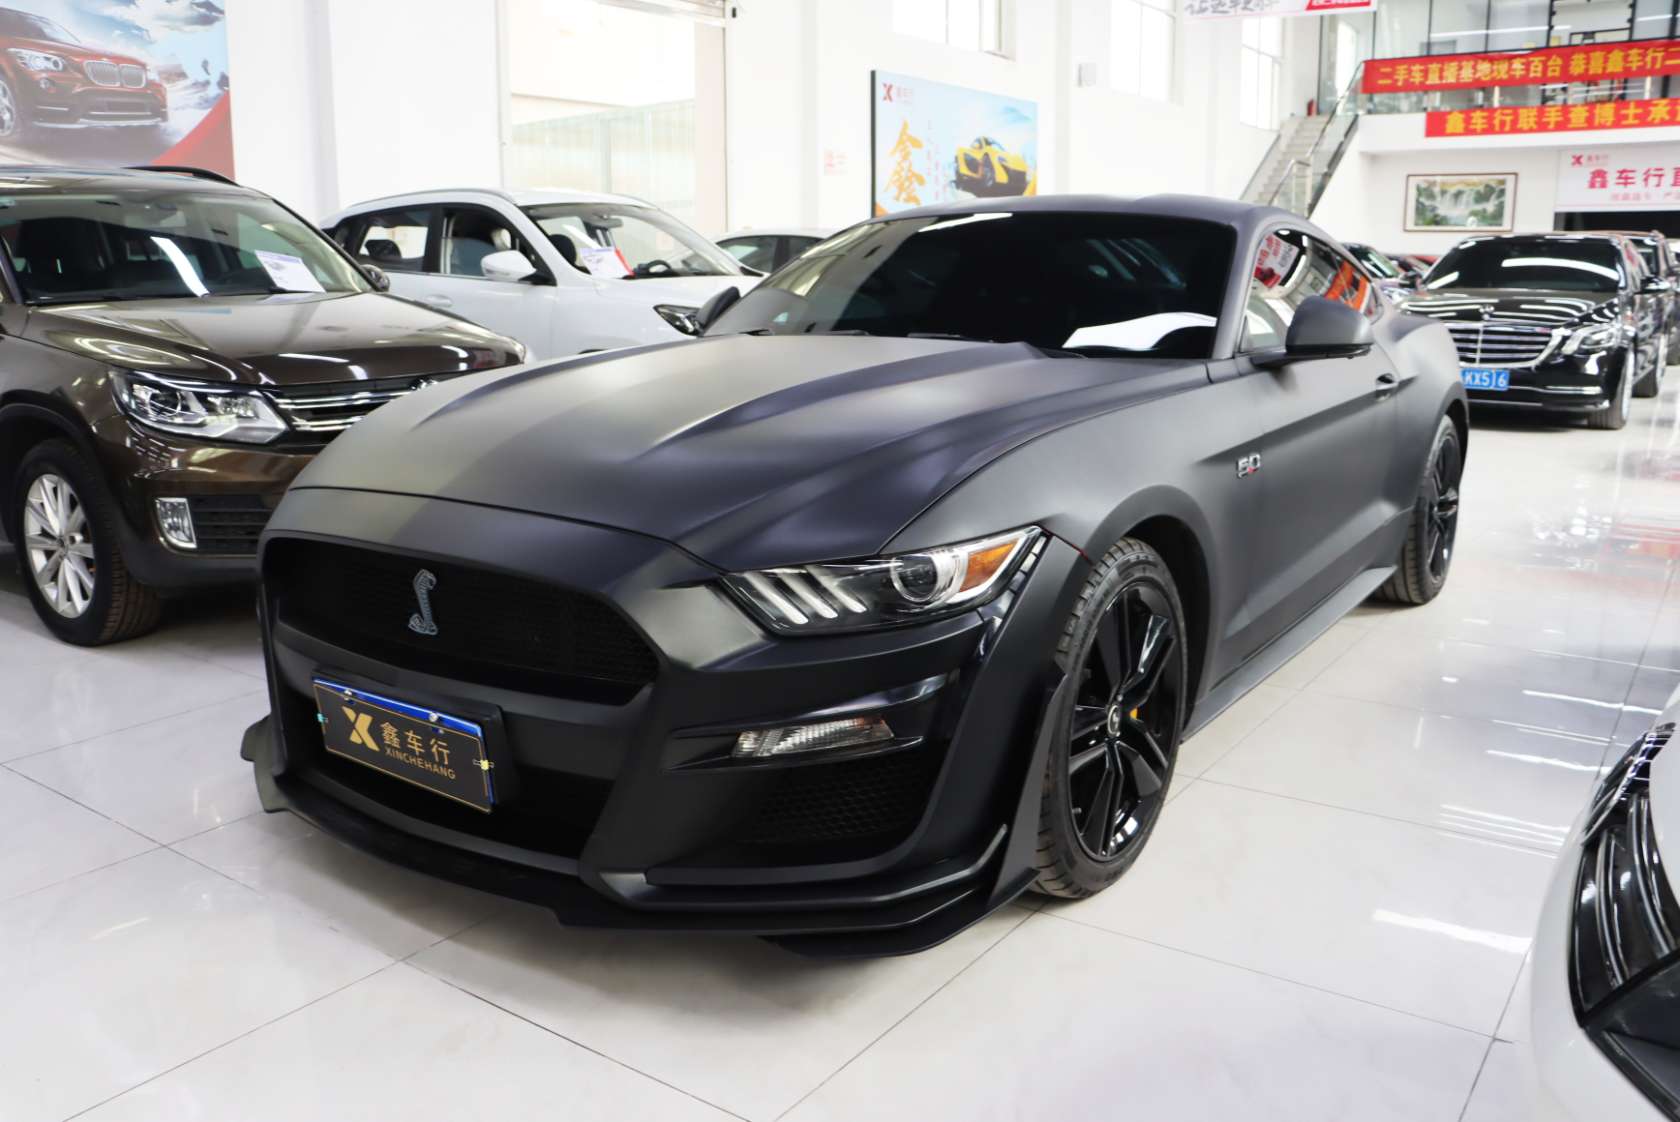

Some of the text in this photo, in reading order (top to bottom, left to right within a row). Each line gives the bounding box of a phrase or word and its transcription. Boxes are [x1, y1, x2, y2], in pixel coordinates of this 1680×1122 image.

[1445, 98, 1680, 134] 鑫车行联手查博士承
[380, 721, 450, 765] 鑫车行
[384, 745, 456, 780] XINCHEHANG
